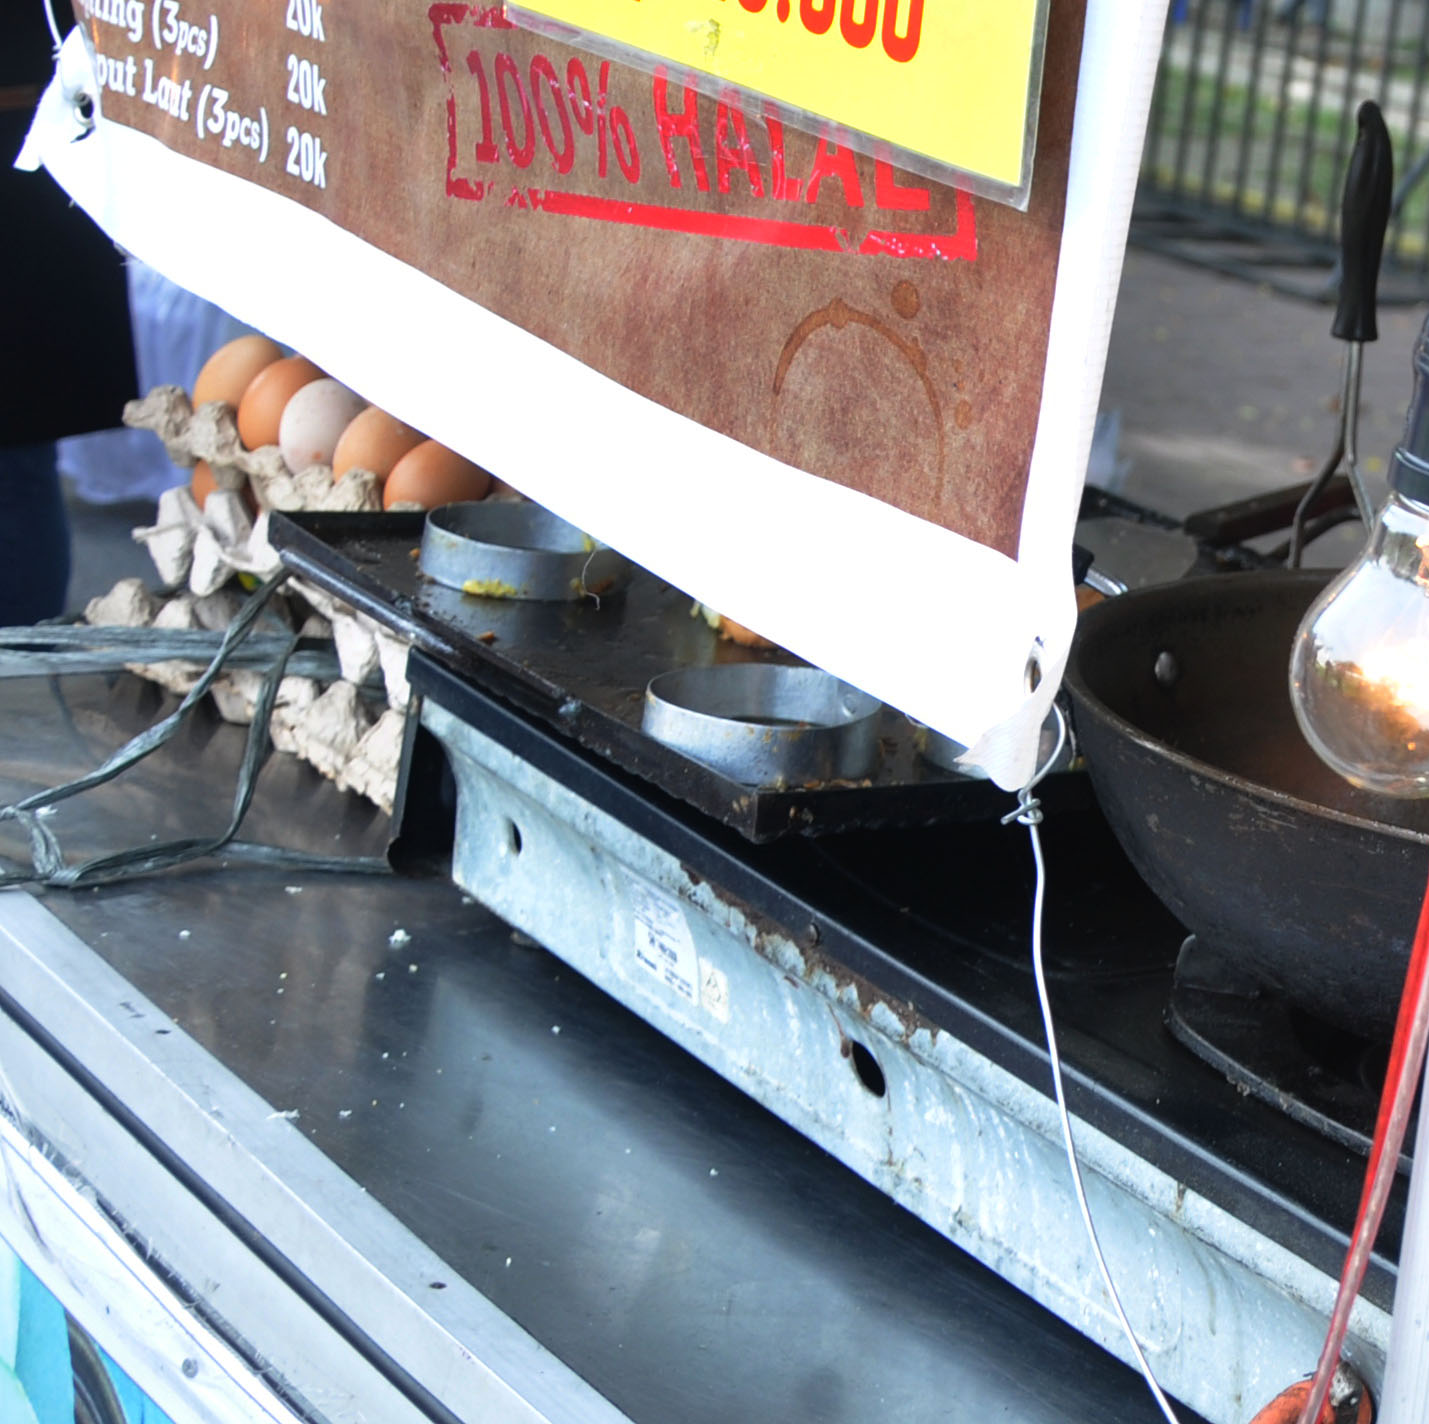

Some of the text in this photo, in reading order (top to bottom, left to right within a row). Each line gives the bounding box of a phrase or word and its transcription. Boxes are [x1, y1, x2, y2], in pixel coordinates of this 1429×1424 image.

[142, 58, 193, 122] Laut
[196, 84, 269, 164] (3pcs)
[286, 126, 328, 189] 20k
[286, 54, 327, 116] 20k
[466, 49, 931, 211] 100% HALAL
